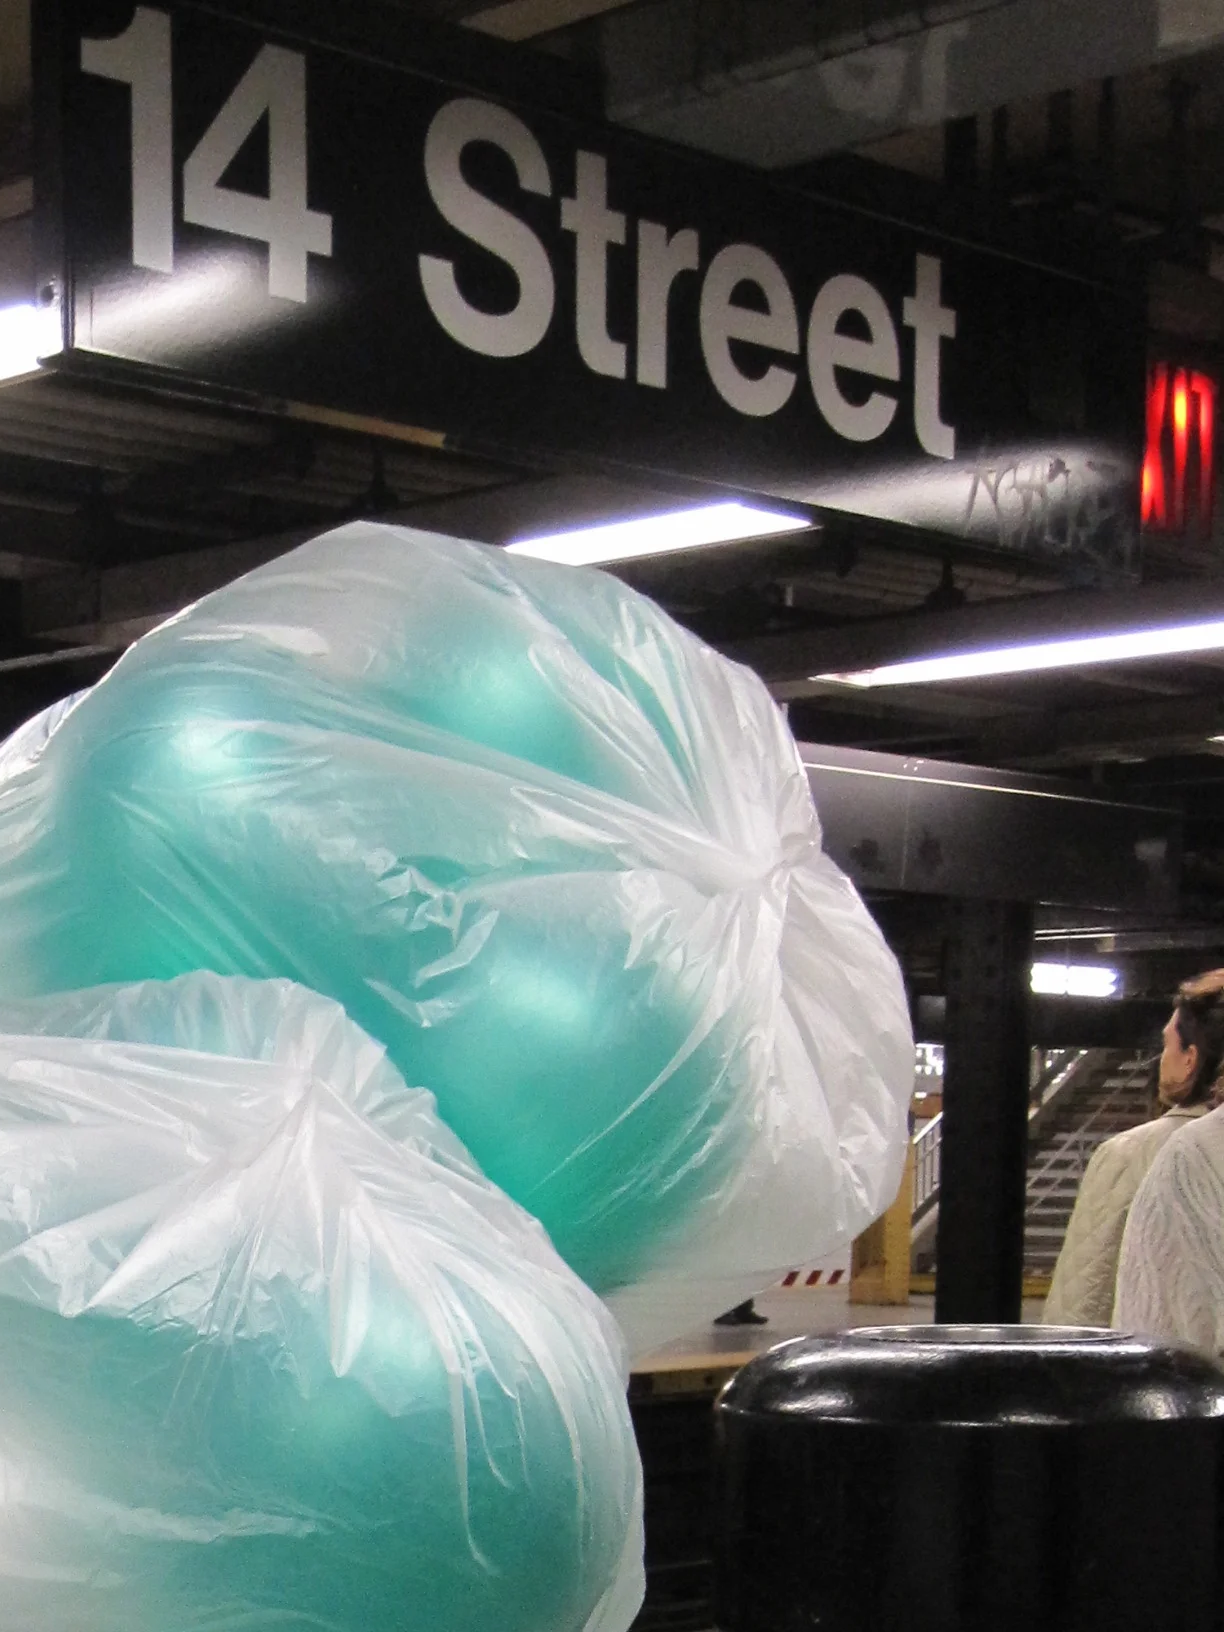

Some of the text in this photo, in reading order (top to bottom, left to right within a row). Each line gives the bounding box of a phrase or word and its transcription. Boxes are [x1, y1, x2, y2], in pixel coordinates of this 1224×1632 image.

[80, 6, 956, 460] 14 Street
[1140, 364, 1215, 526] XIT
